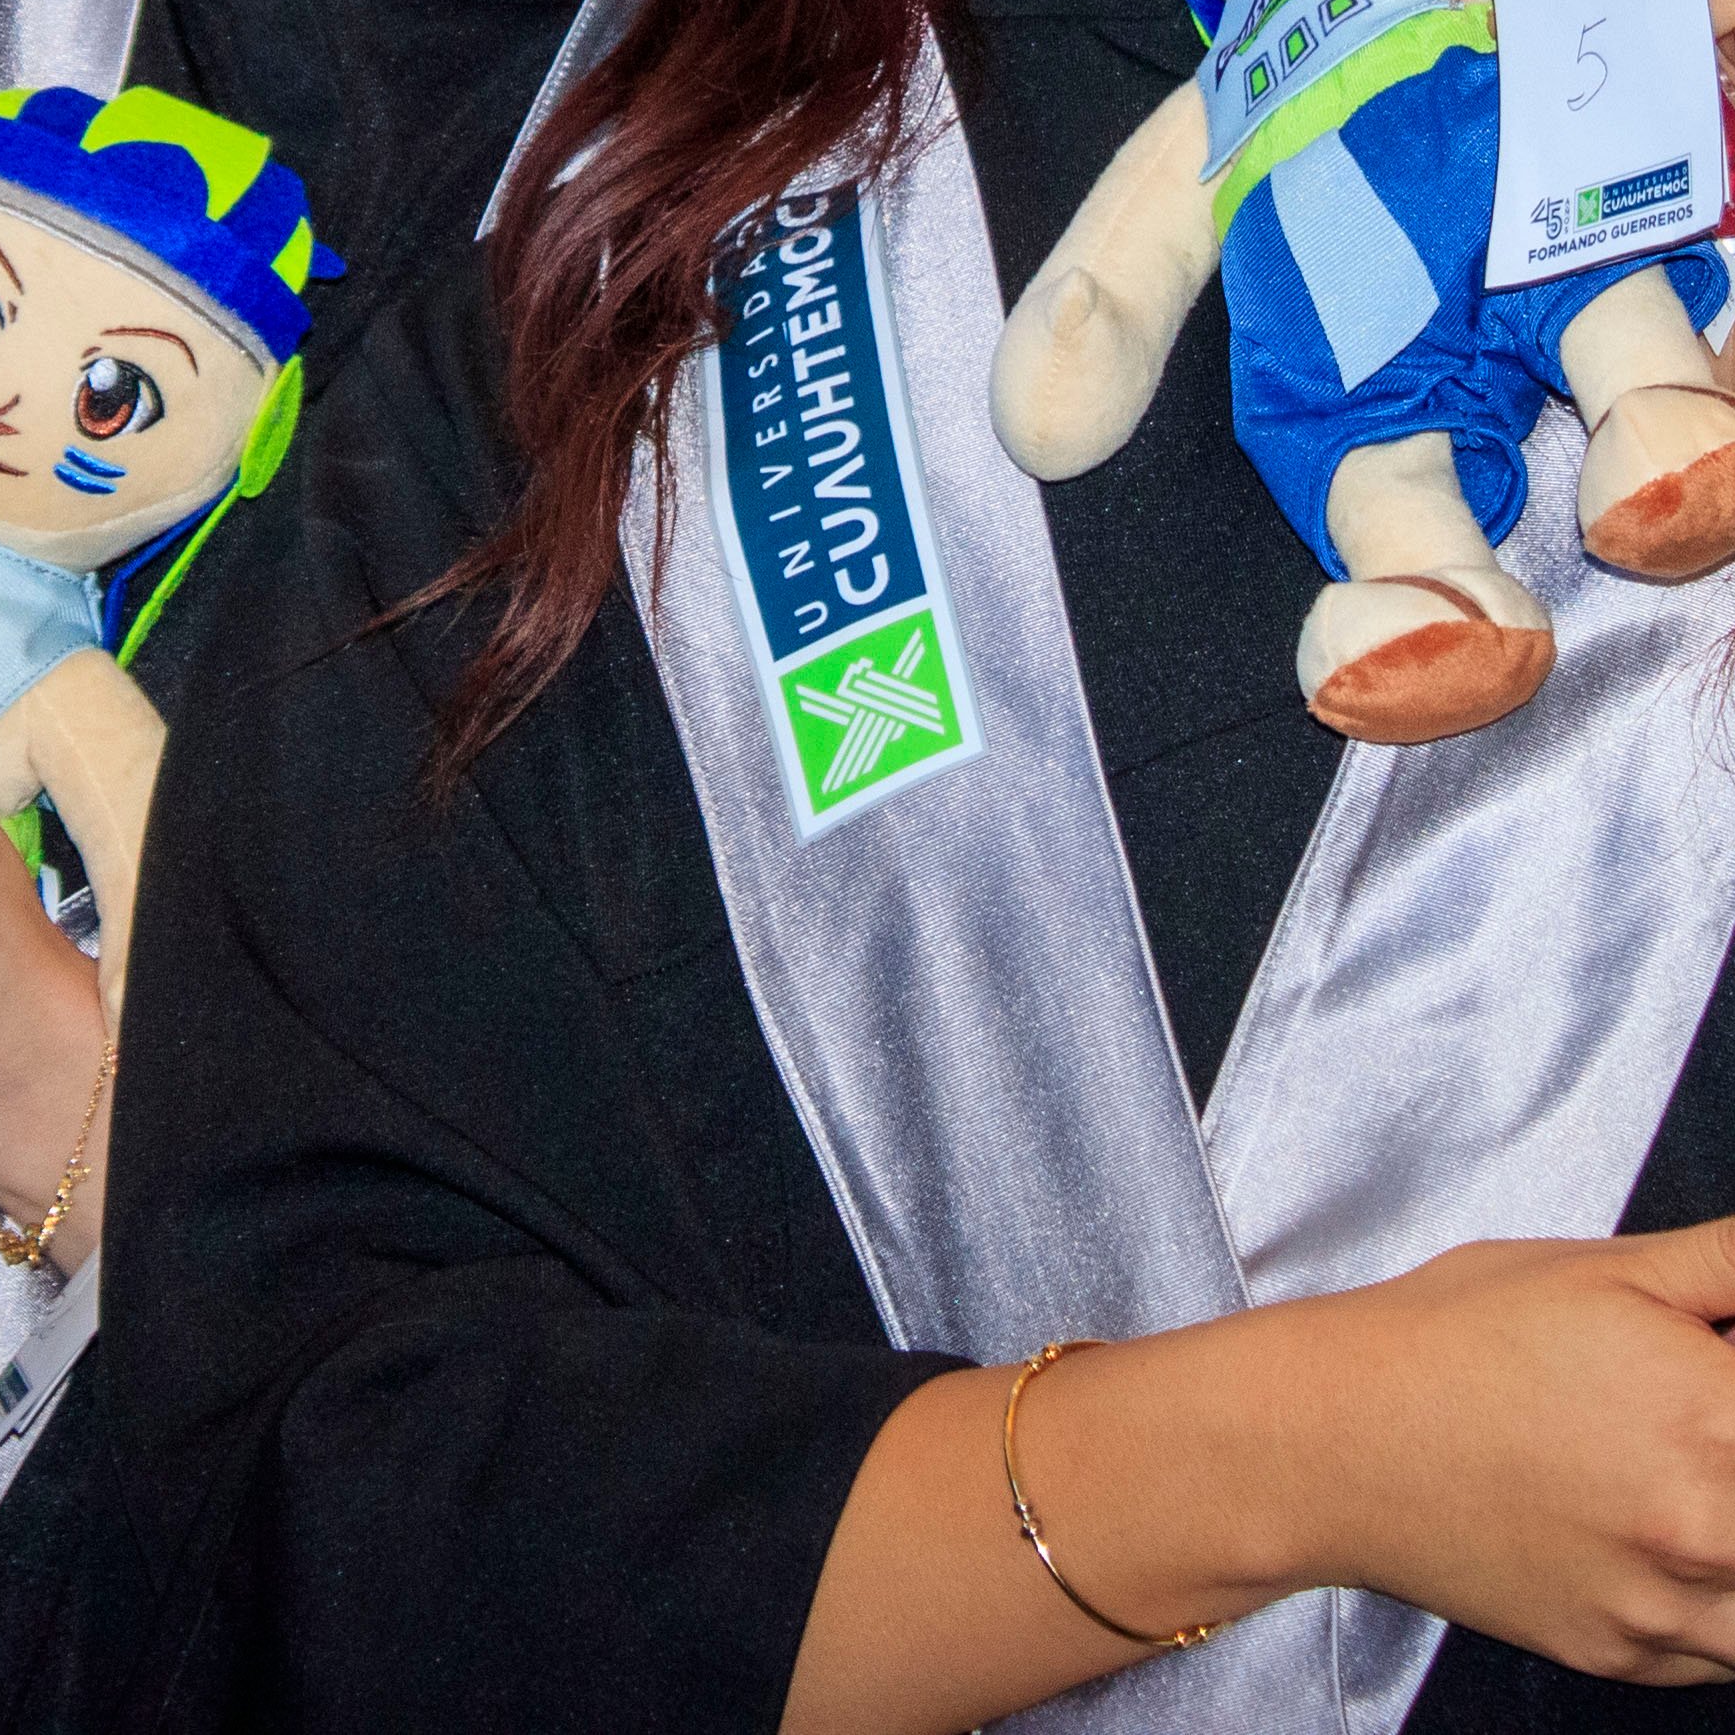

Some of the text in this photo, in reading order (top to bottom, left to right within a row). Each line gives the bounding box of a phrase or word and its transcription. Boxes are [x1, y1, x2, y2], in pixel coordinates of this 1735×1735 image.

[1566, 17, 1608, 112] 5
[1603, 167, 1688, 199] UNIVERSIDAD
[1528, 204, 1694, 264] FORMANDO GUERREROS
[1530, 196, 1564, 240] 45
